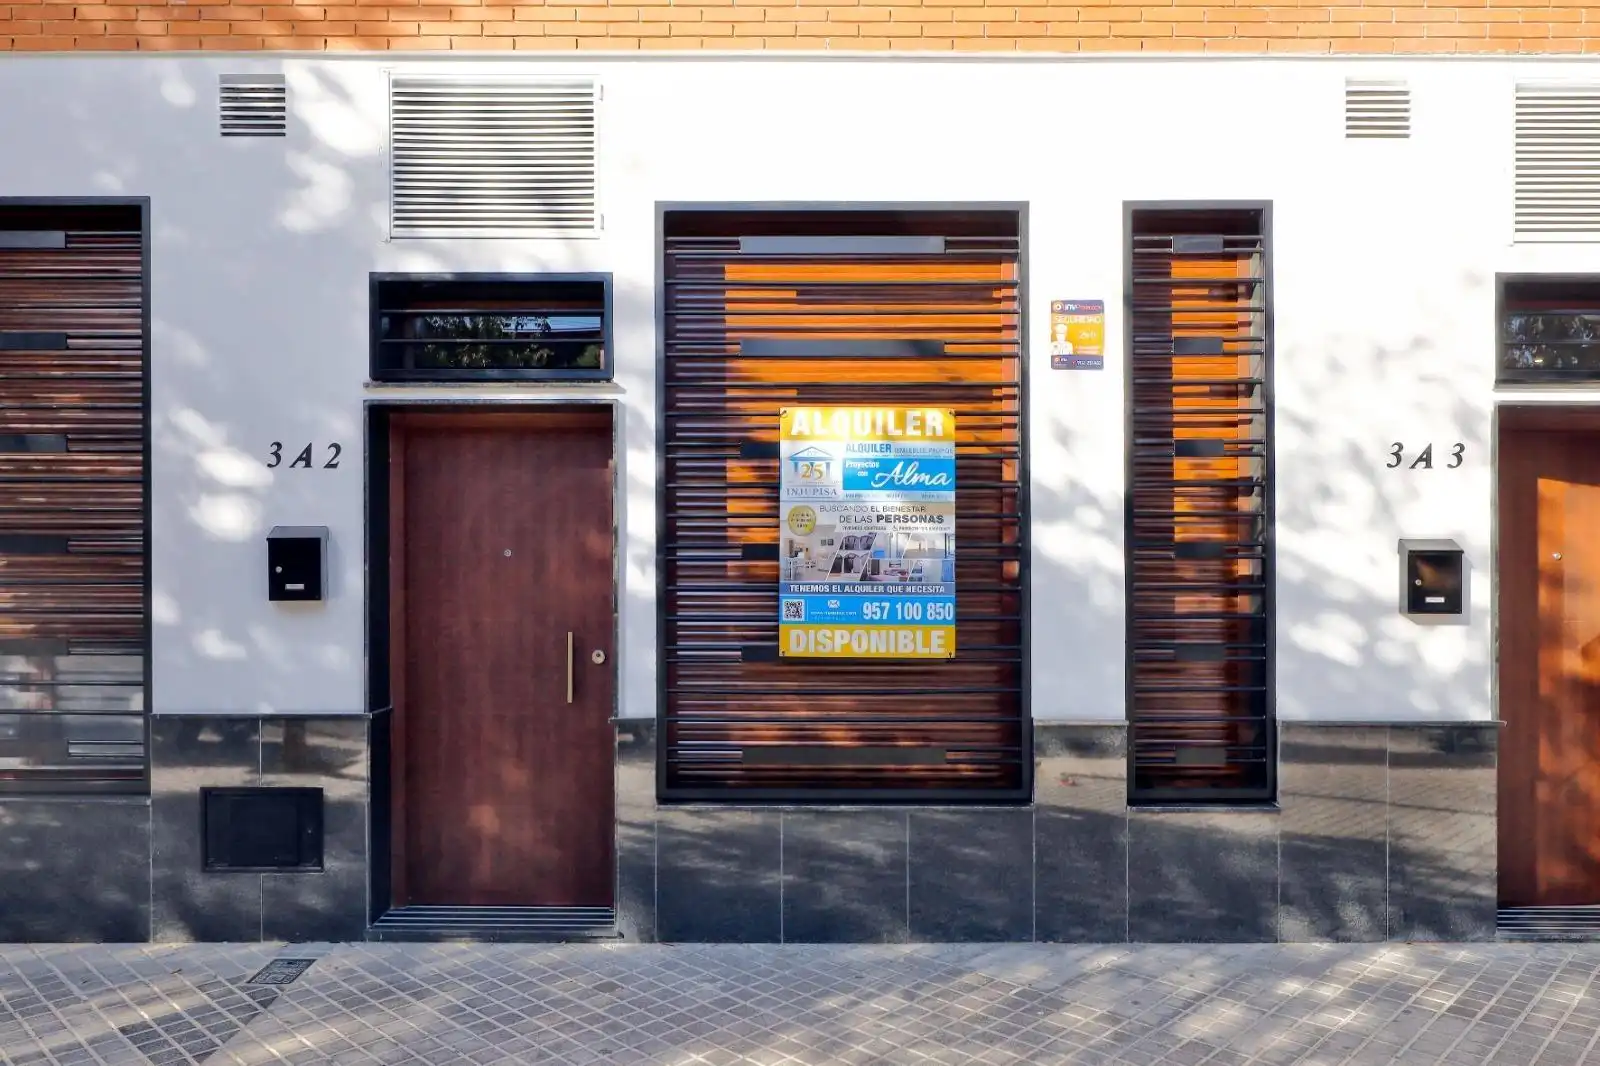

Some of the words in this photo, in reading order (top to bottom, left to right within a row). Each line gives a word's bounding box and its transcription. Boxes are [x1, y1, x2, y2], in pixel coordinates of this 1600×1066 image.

[790, 409, 944, 436] ALQUILER
[845, 443, 892, 453] ALQUILER
[845, 460, 880, 470] Proyectos
[801, 463, 824, 480] 25
[871, 461, 953, 488] Alma
[786, 487, 838, 496] INJUPISA
[819, 505, 868, 513] BUSCANDO
[870, 505, 880, 513] EL
[882, 505, 927, 513] BIENESTAR
[839, 515, 853, 524] DE
[854, 515, 873, 524] LAS
[876, 514, 945, 524] PERSONAS
[789, 584, 830, 593] TENEMOS
[832, 585, 842, 593] EL
[844, 585, 885, 594] ALQUILER
[887, 585, 903, 594] QUE
[906, 585, 945, 593] NECESITA
[863, 602, 889, 620] 957
[896, 602, 922, 620] 100
[926, 602, 954, 620] 850
[789, 629, 945, 654] DISPONIBLE
